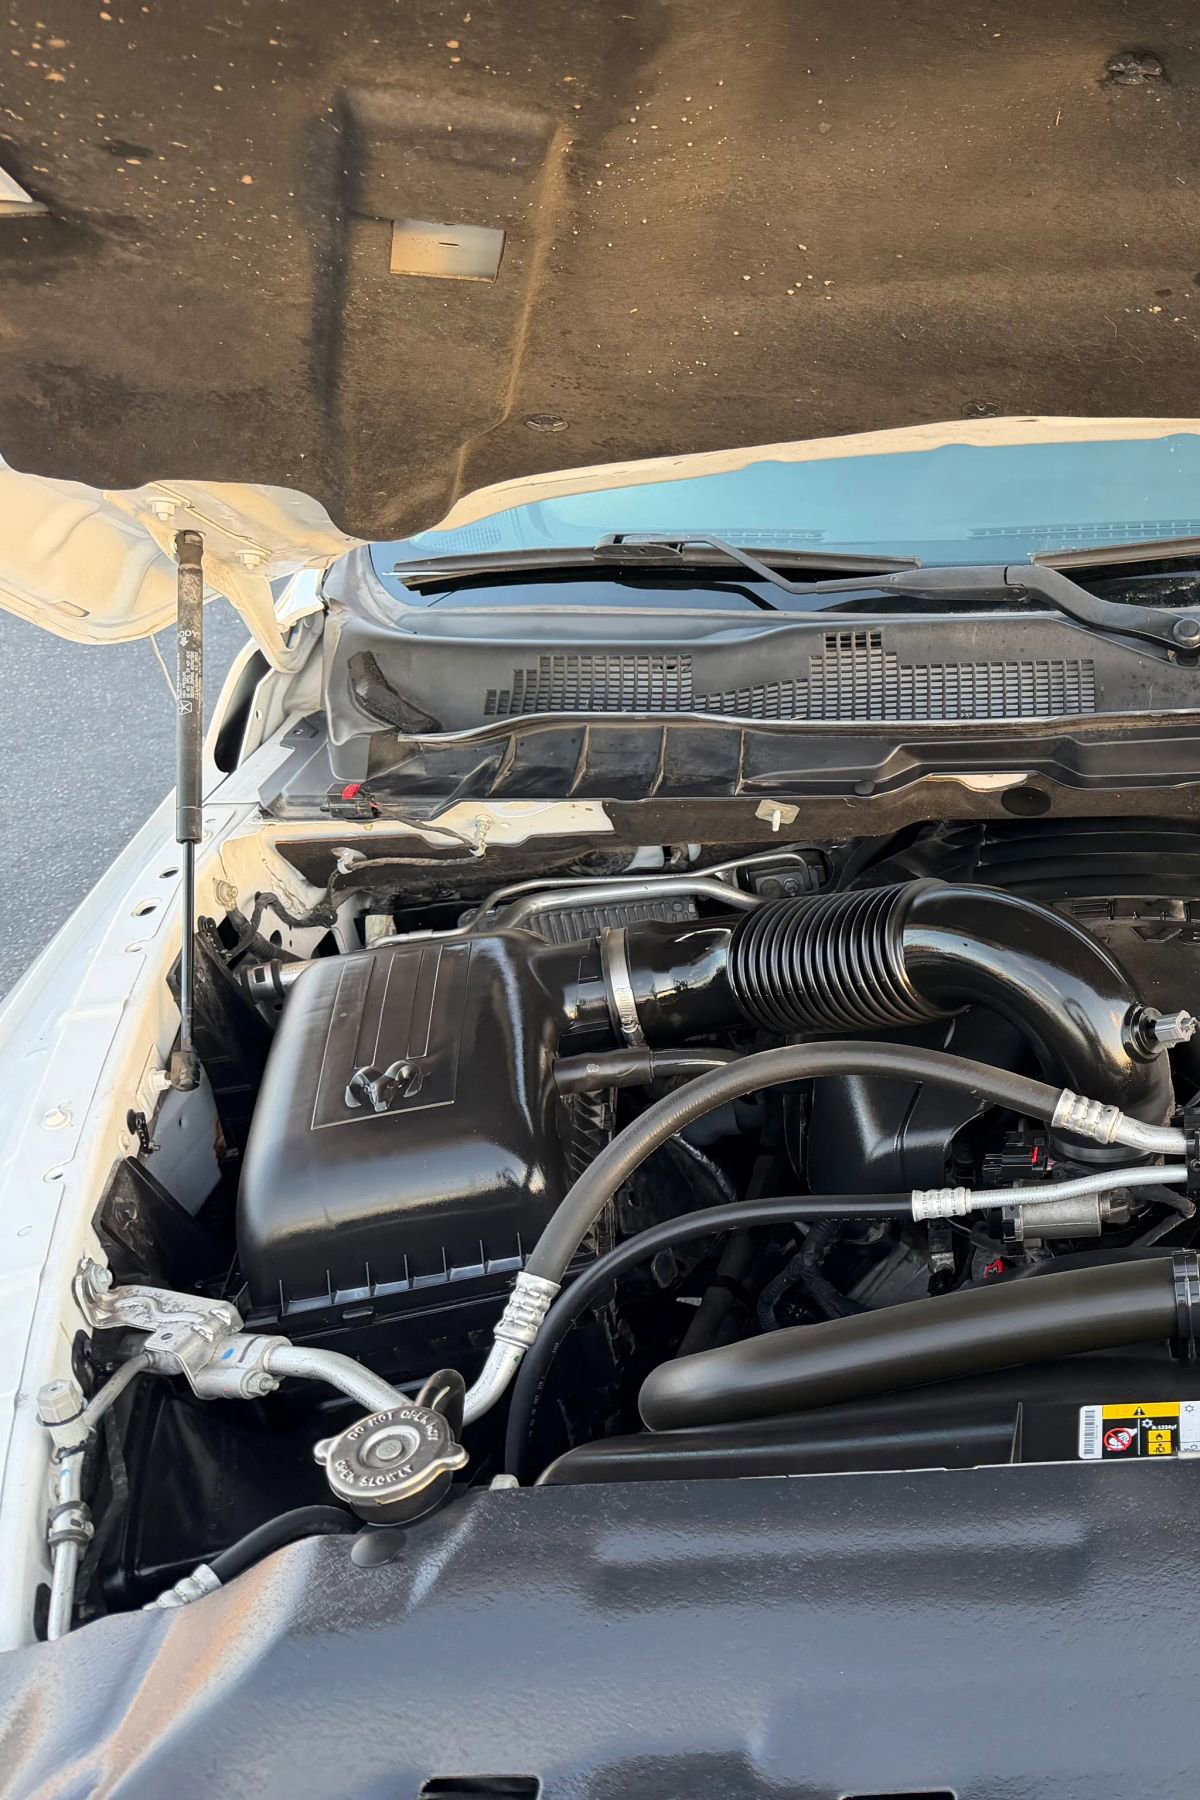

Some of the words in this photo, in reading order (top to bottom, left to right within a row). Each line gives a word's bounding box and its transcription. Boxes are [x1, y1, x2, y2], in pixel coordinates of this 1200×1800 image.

[348, 1427, 364, 1440] DO
[368, 1412, 394, 1427] NOT
[401, 1410, 428, 1425] OPEN
[335, 1459, 355, 1485] OPEN
[360, 1464, 414, 1487] SLOWLY
